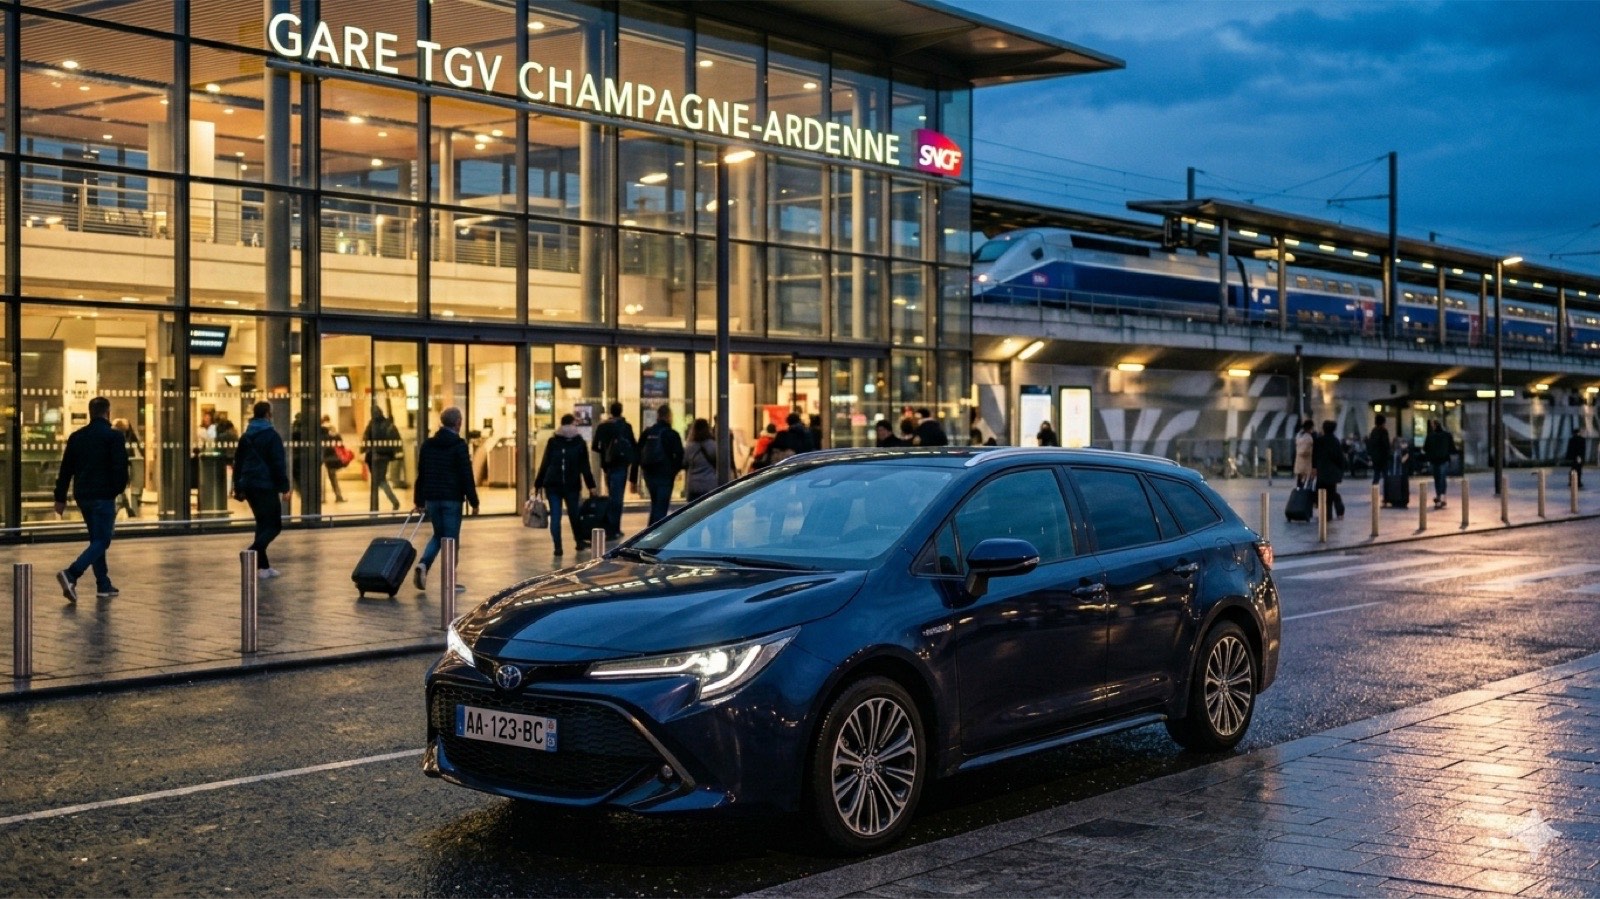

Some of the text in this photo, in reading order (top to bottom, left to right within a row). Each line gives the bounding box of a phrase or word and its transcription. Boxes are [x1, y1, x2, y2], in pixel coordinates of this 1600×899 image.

[268, 12, 900, 166] GARE TGV CHAMPAGNE-ARDENNE
[919, 144, 962, 171] SNCF
[466, 711, 544, 744] AA-123-BC
